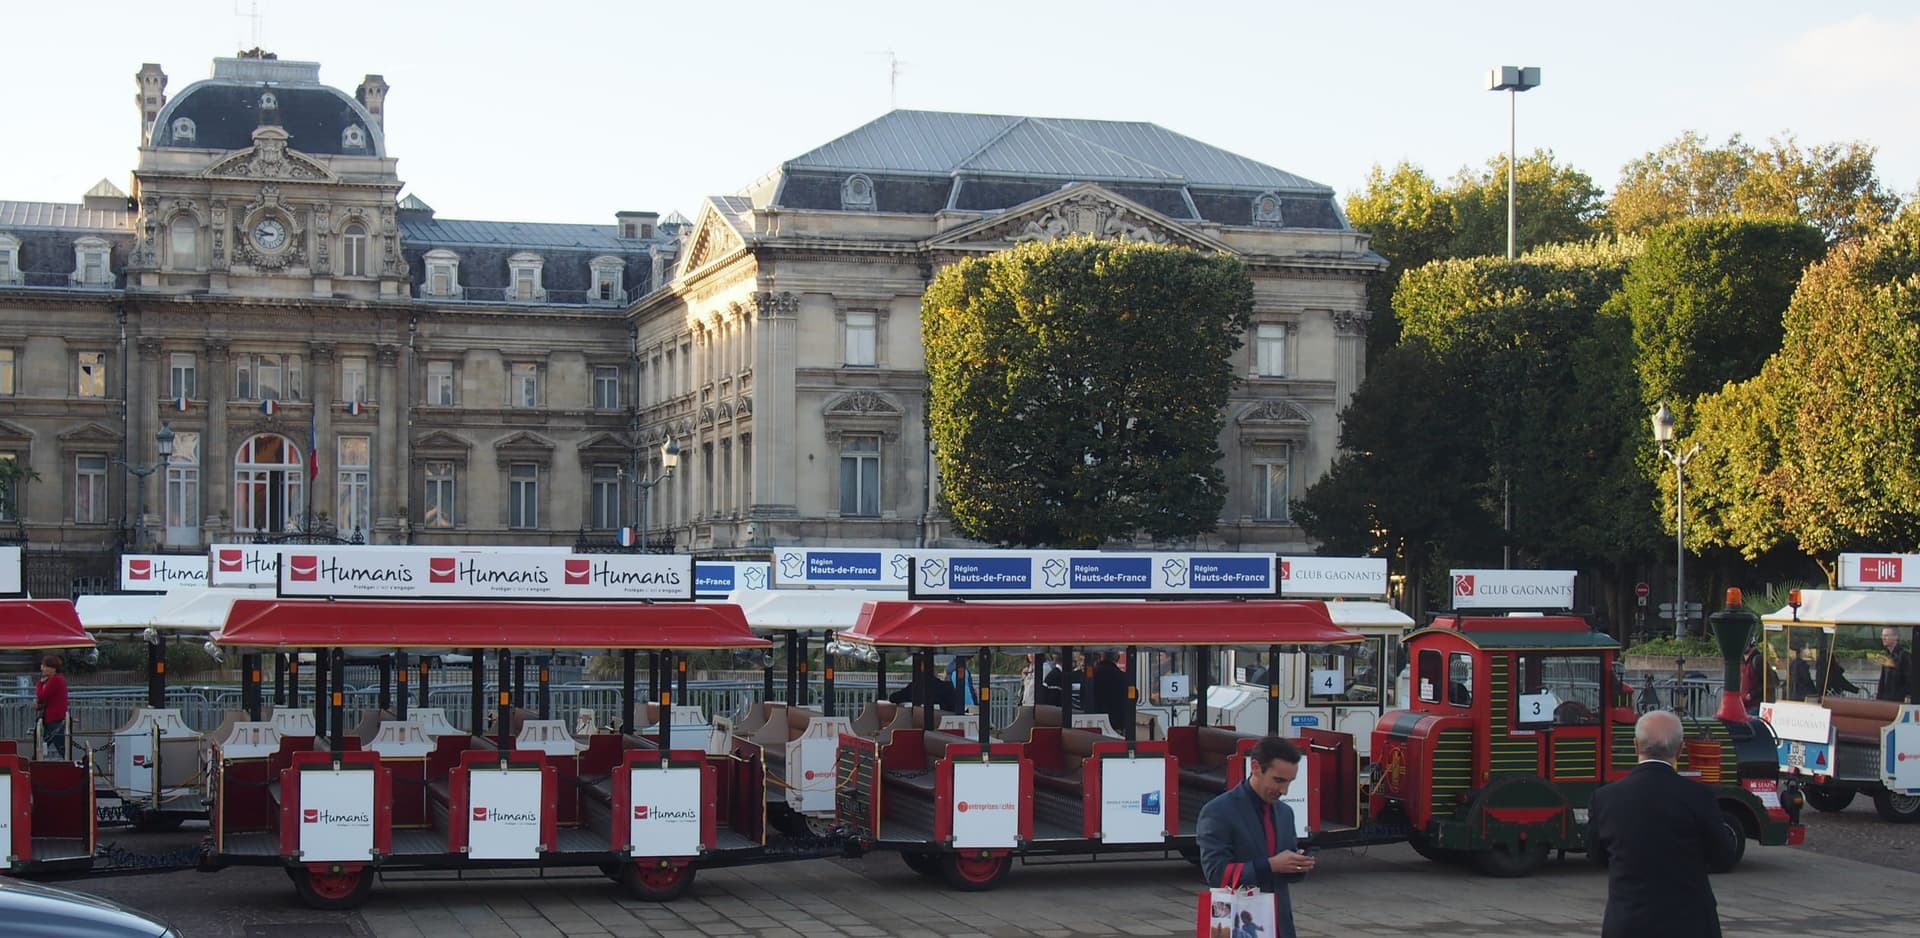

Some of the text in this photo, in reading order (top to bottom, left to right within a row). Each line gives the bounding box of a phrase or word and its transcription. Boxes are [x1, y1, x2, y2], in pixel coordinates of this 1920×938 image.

[810, 558, 833, 566] Région
[322, 556, 413, 584] Humanis
[460, 558, 548, 585] Humanis
[594, 560, 680, 587] Humanis
[810, 566, 877, 574] Hauts-de-France
[953, 565, 978, 573] Région
[1074, 565, 1099, 573] Région
[1194, 565, 1218, 573] Région
[953, 574, 1027, 582] Hauts-de-France
[1074, 573, 1147, 582] Hauts-de-France
[1194, 573, 1265, 582] Hauts-de-France
[1295, 570, 1382, 580] CLUB GAGNANTS
[1479, 585, 1572, 596] CLUB GAGNANTS
[1171, 681, 1179, 692] 5
[1324, 676, 1333, 688] 4
[1532, 701, 1541, 715] 3
[320, 809, 369, 824] Humanis
[489, 808, 537, 822] Humanis
[649, 805, 696, 820] Humanis
